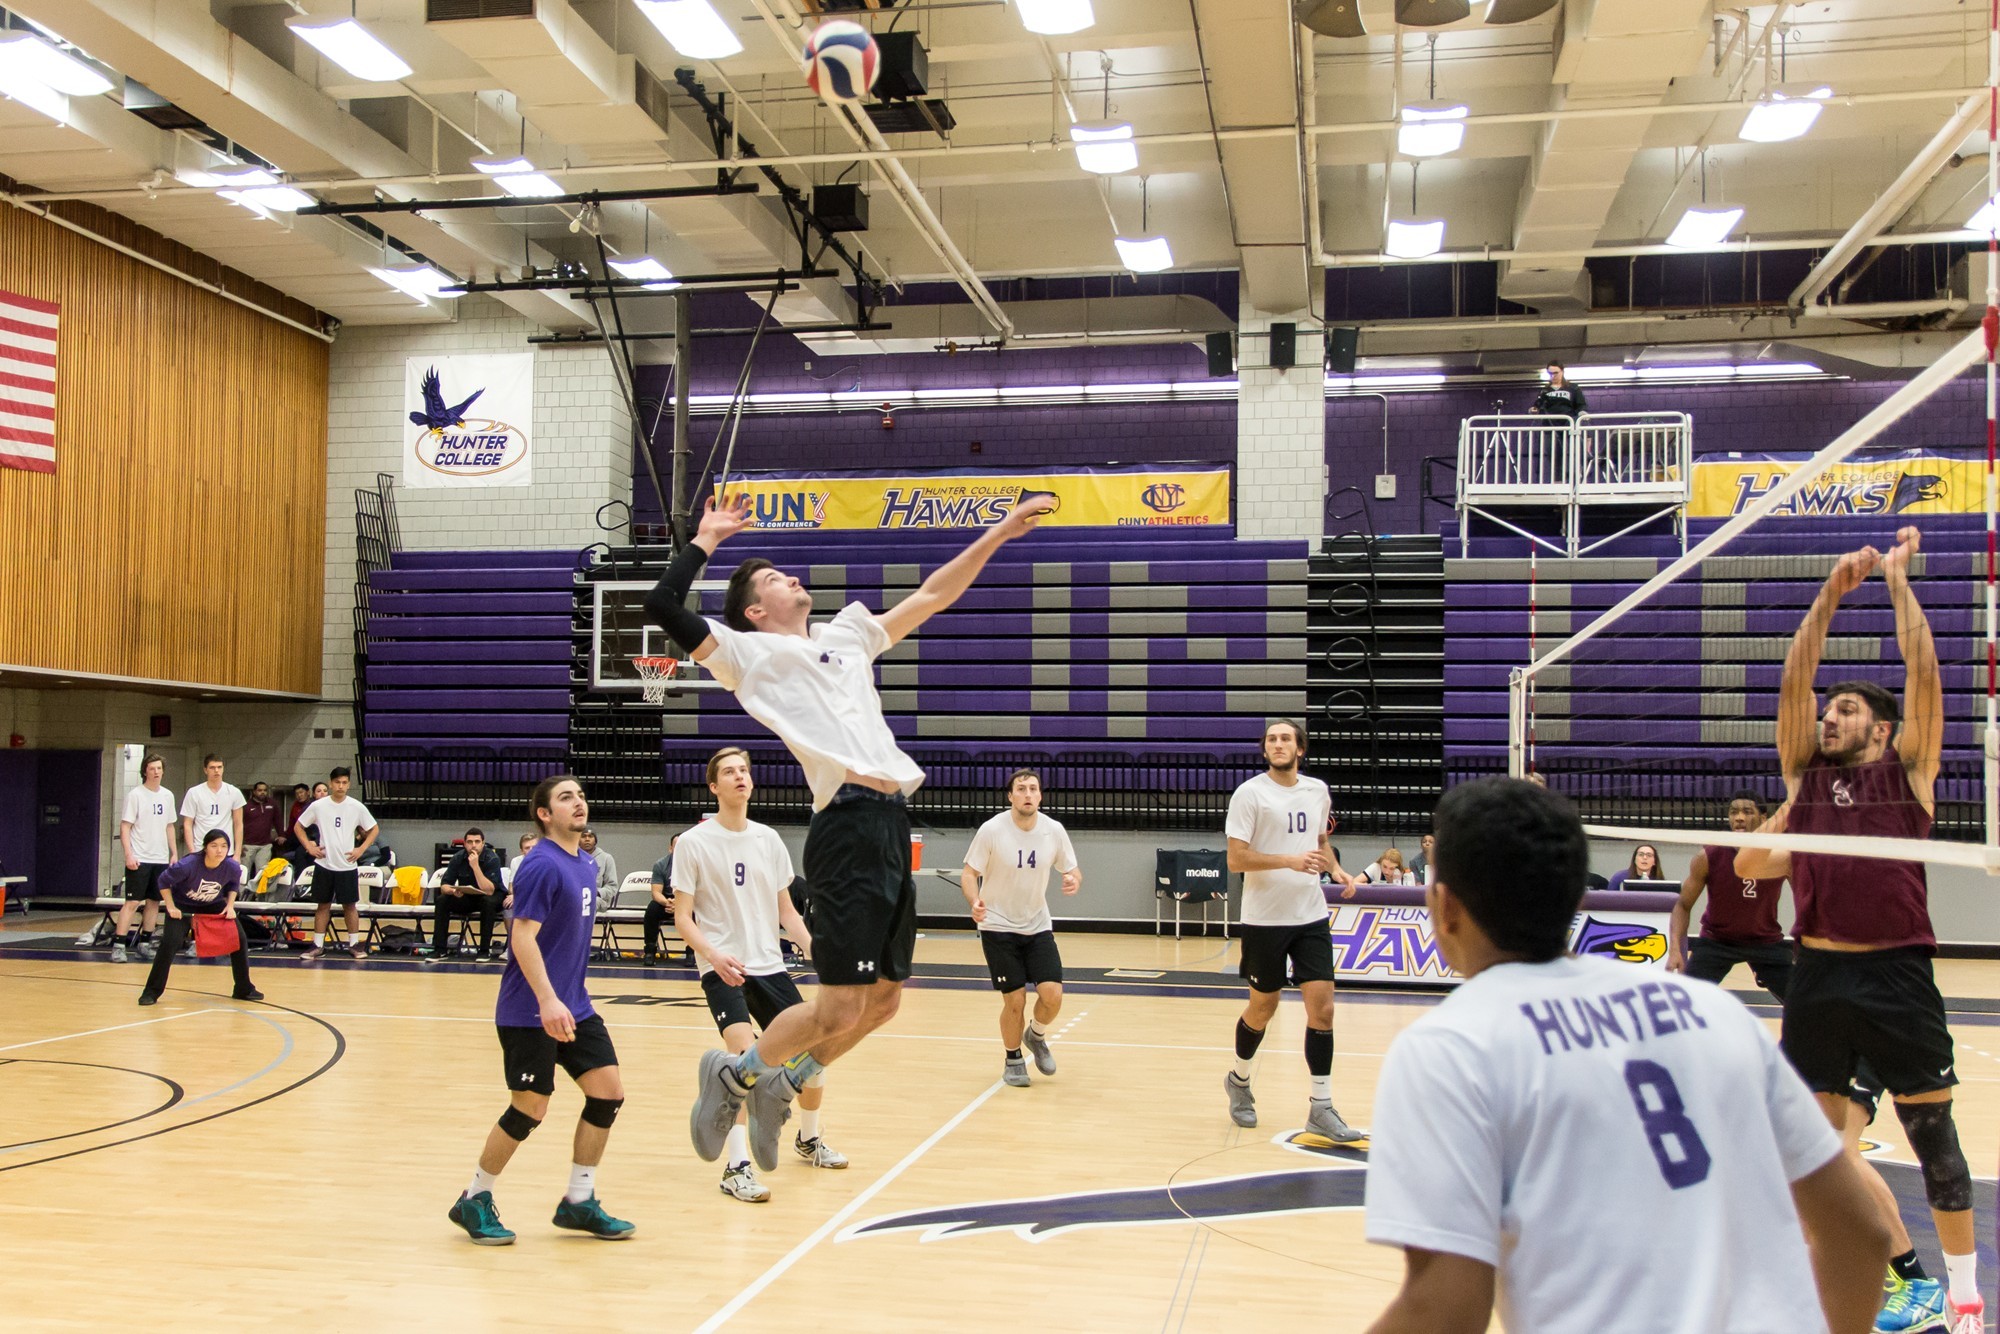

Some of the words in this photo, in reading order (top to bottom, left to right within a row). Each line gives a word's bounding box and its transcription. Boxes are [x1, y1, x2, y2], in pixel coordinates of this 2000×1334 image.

[440, 435, 508, 449] HUNTER
[434, 453, 502, 466] COLLEGE
[925, 487, 967, 496] HUNTER
[970, 485, 1021, 495] COLLEGE
[878, 488, 1017, 529] HAWKS
[153, 803, 163, 815] 13
[210, 804, 219, 815] 11
[334, 816, 342, 828] 6
[1287, 811, 1307, 834] 10
[1017, 850, 1036, 869] 14
[734, 862, 745, 886] 9
[1185, 868, 1219, 878] molten
[1742, 877, 1757, 898] 2
[581, 887, 592, 917] 2
[1327, 907, 1465, 978] HAW
[1519, 977, 1708, 1055] HUNTER
[1623, 1059, 1712, 1190] 8
